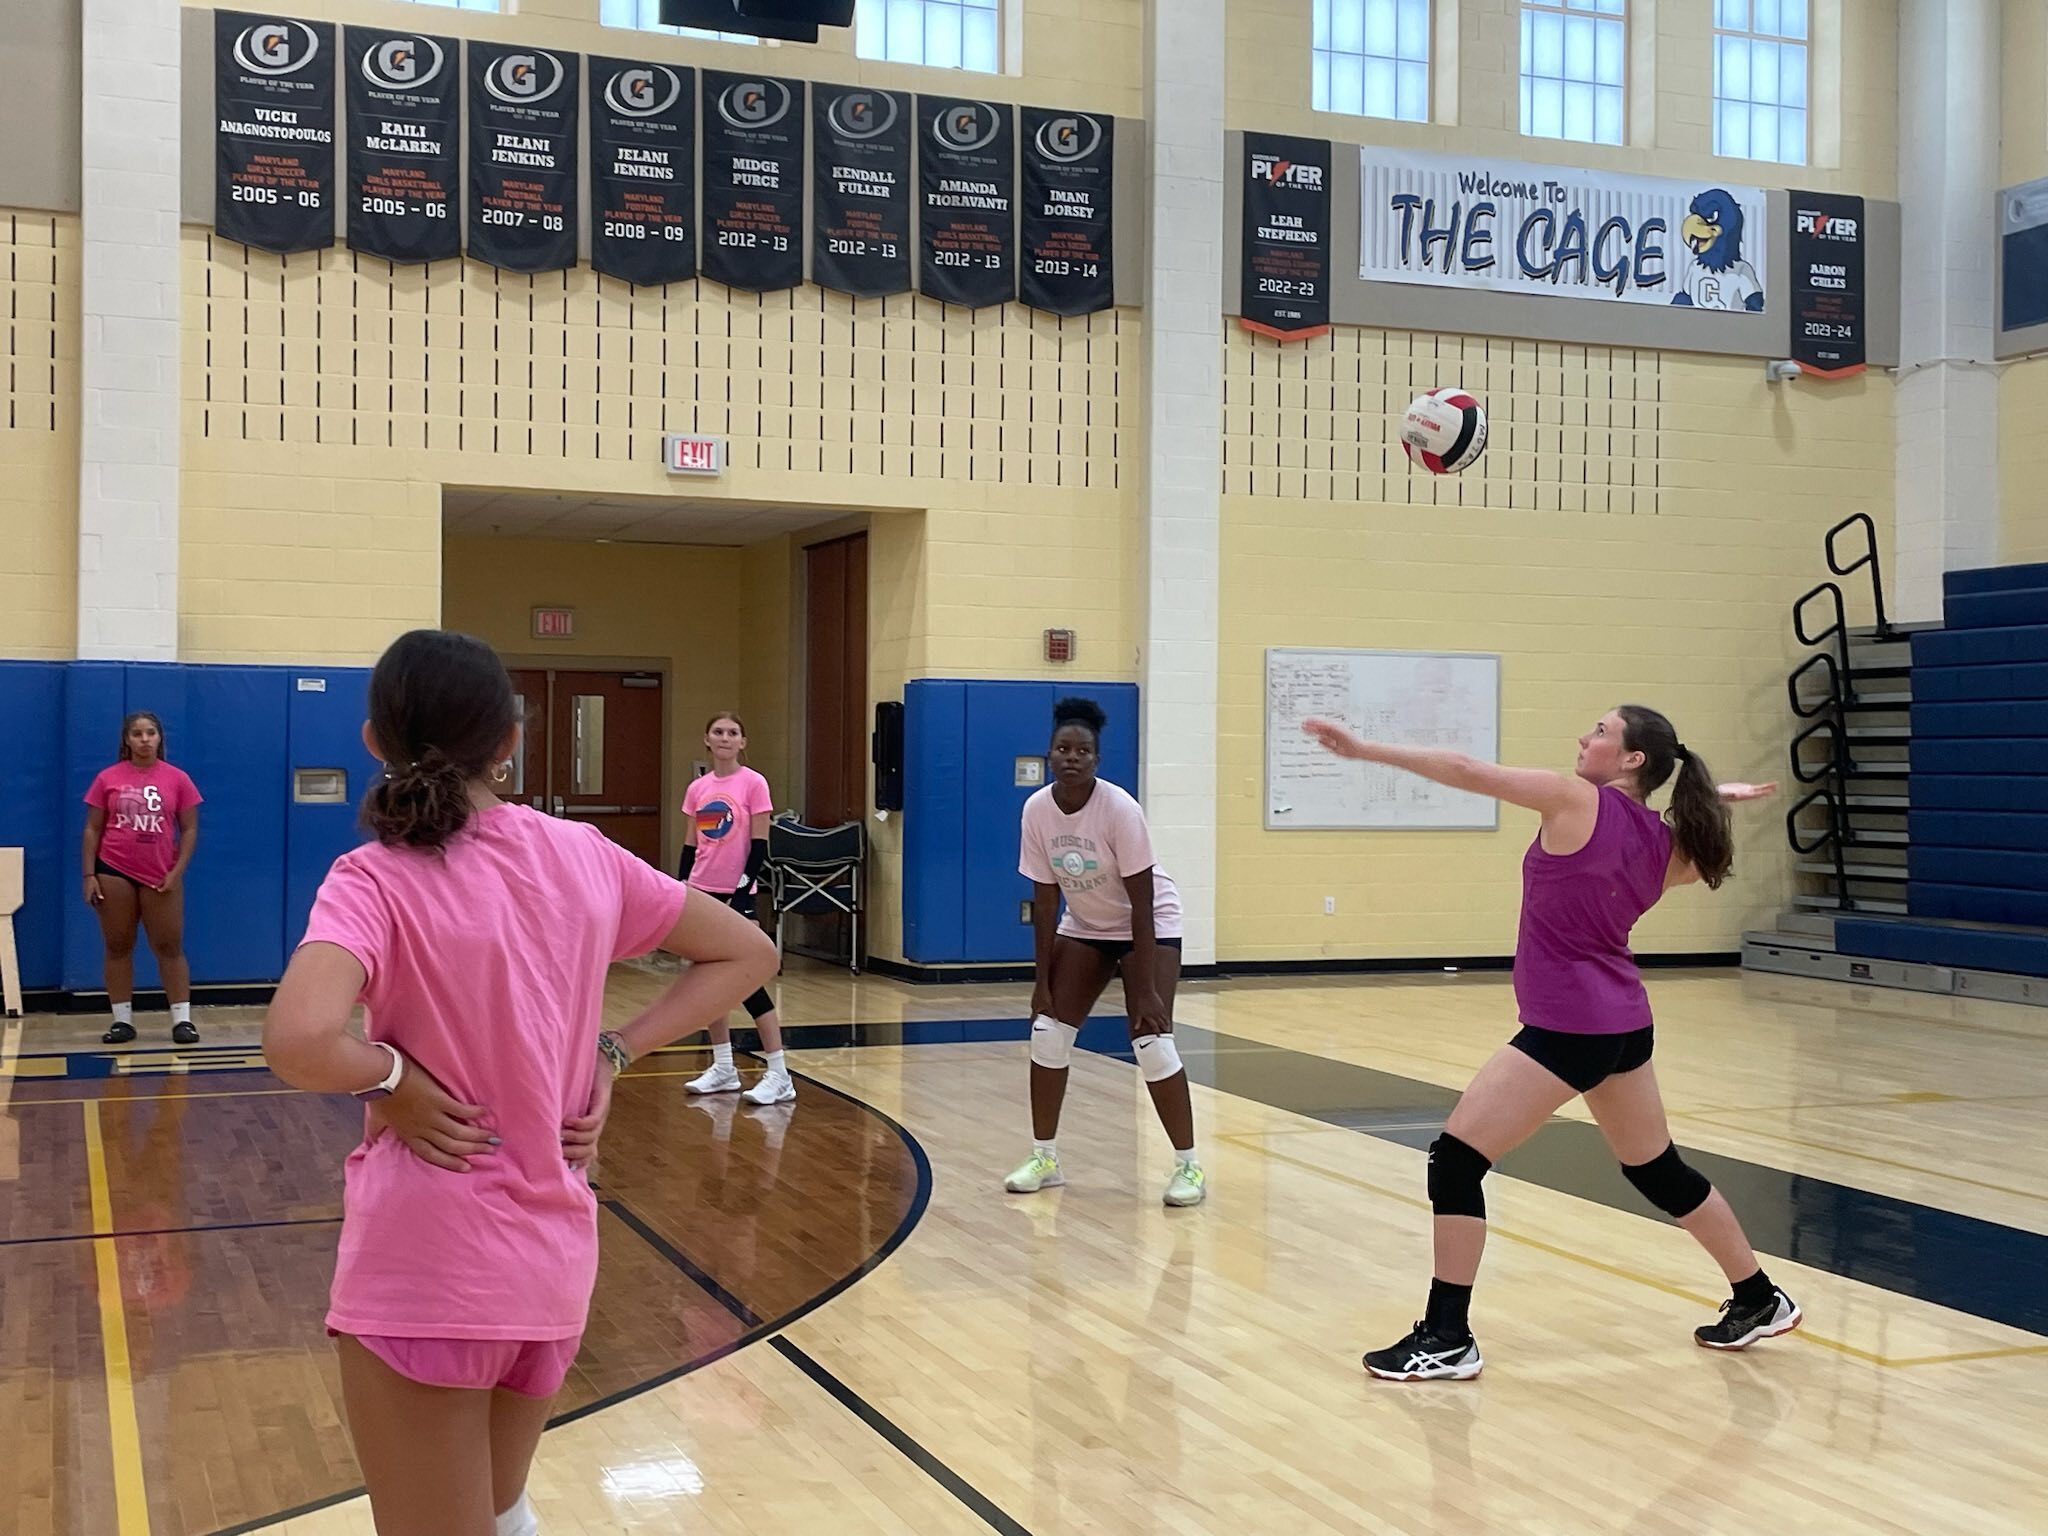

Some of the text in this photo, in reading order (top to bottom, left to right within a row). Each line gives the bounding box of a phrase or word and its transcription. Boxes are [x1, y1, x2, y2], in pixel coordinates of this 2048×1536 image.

[254, 108, 298, 124] VICKI
[220, 120, 331, 143] ANAGNOSTOPOULOS
[381, 121, 426, 138] KAILI
[366, 136, 441, 154] McLAREN
[496, 134, 550, 152] JELANI
[492, 149, 555, 168] JENKINS
[618, 148, 668, 164] JELANI
[614, 162, 674, 180] JENKINS
[732, 158, 779, 174] MIDGE
[832, 166, 896, 184] KENDALL
[1252, 160, 1322, 185] PLYER
[732, 173, 779, 188] PURCE
[838, 181, 890, 198] FULLER
[940, 180, 998, 195] AMANDA
[1458, 171, 1567, 203] Welcome To
[232, 185, 277, 204] 2005
[298, 191, 320, 208] 06
[928, 194, 1008, 210] FIORAVANTI
[1050, 190, 1089, 204] IMANI
[362, 197, 405, 216] 2005
[426, 202, 446, 218] 06
[1044, 204, 1094, 218] DORSEY
[482, 209, 524, 226] 2007
[543, 215, 563, 231] 08
[1270, 215, 1302, 228] LEAH
[1797, 216, 1857, 236] PLYER
[604, 222, 645, 239] 2008
[664, 226, 684, 241] 09
[1258, 227, 1317, 242] STEPHENS
[719, 231, 756, 248] 2012
[773, 236, 788, 251] 13
[829, 239, 865, 255] 2012
[882, 243, 896, 258] 13
[1391, 194, 1666, 297] THE CAGE
[935, 251, 970, 266] 2012
[985, 255, 1000, 268] 13
[1035, 260, 1069, 275] 2013
[1083, 264, 1097, 277] 14
[1810, 264, 1846, 276] AARON
[1259, 278, 1314, 296] 2022-23
[1805, 322, 1851, 338] 2023-24
[681, 442, 713, 468] EXIT
[543, 614, 570, 634] EXIT
[116, 813, 165, 833] PNK
